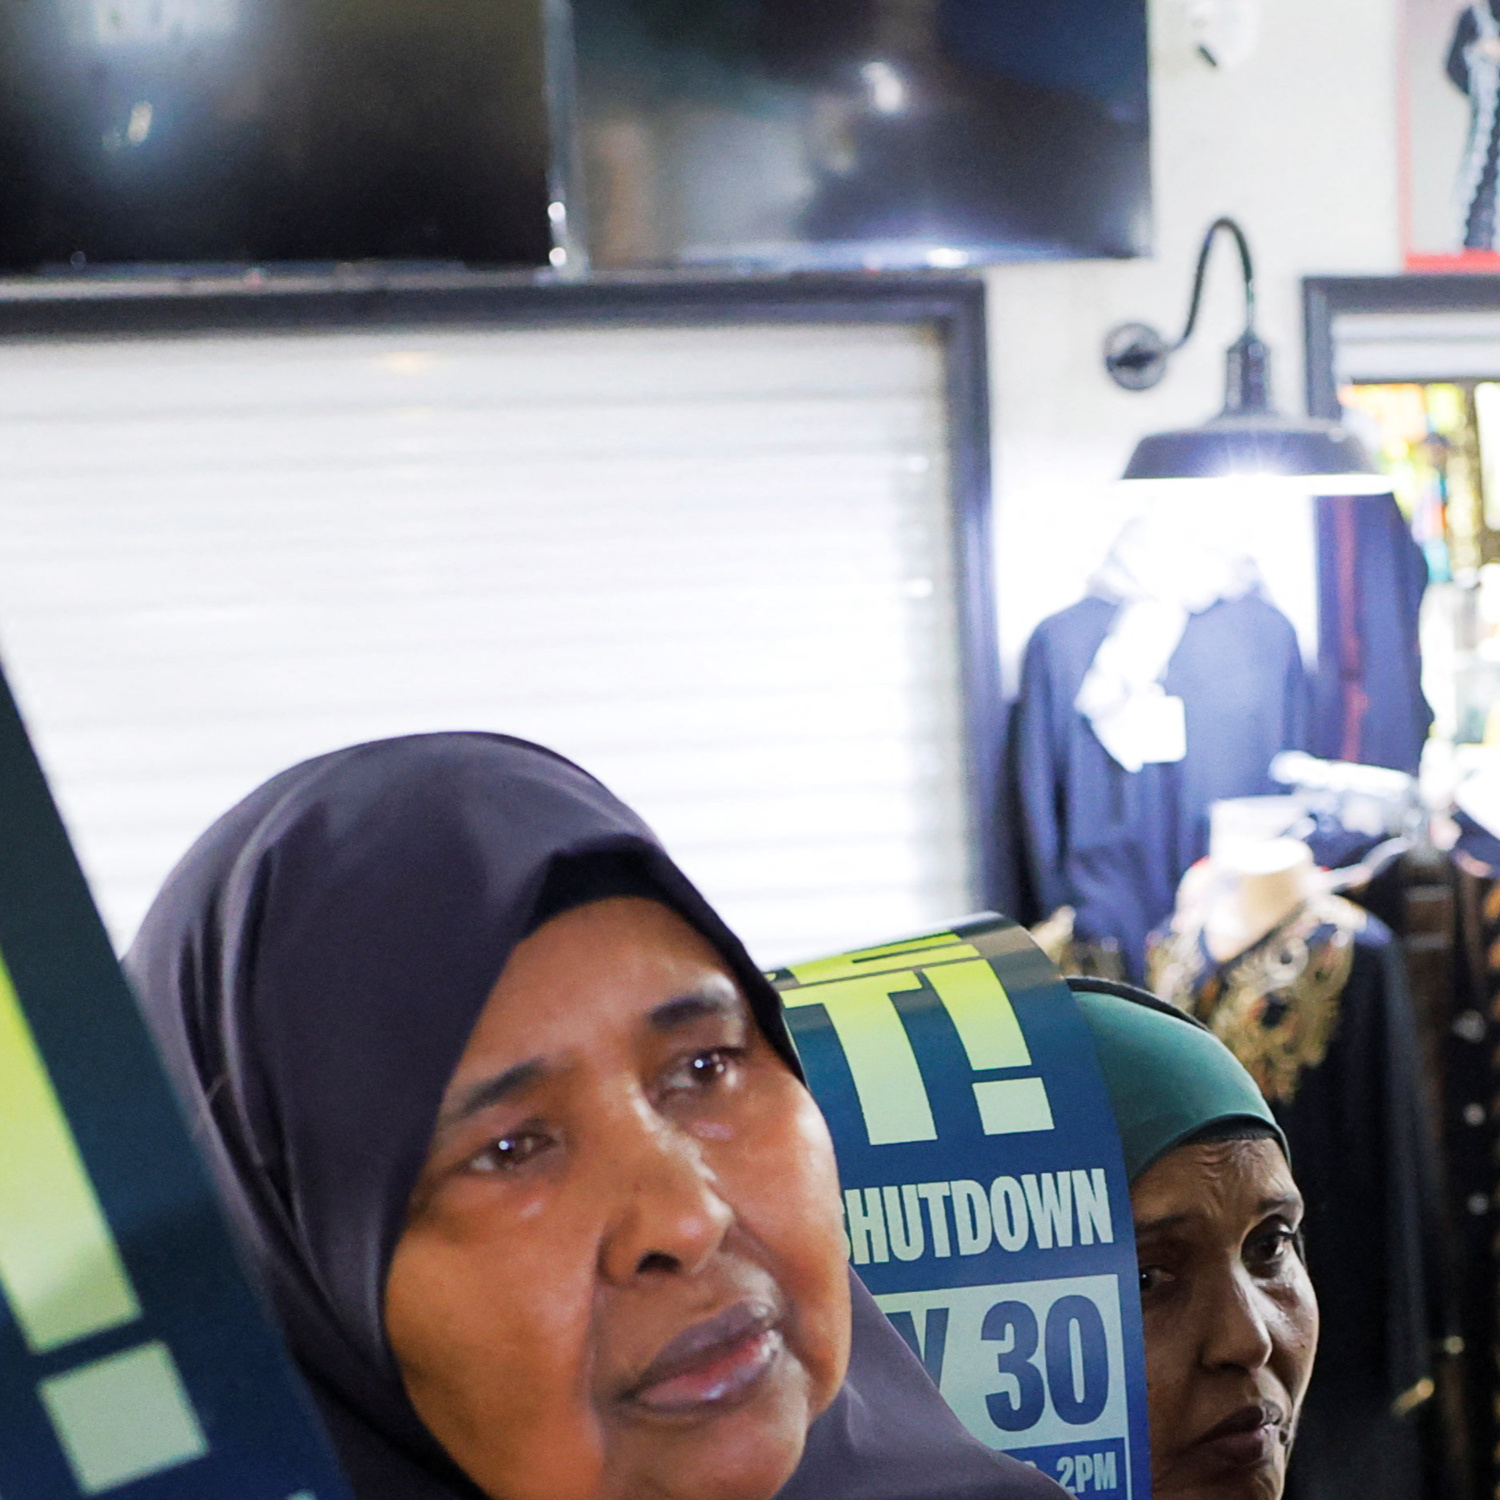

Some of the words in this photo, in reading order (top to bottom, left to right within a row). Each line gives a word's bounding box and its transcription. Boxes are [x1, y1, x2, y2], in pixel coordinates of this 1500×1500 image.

[779, 958, 1055, 1145] T!
[842, 1168, 1114, 1265] HUTDOWN
[980, 1294, 1110, 1433] 30
[1056, 1451, 1117, 1494] 2PM
